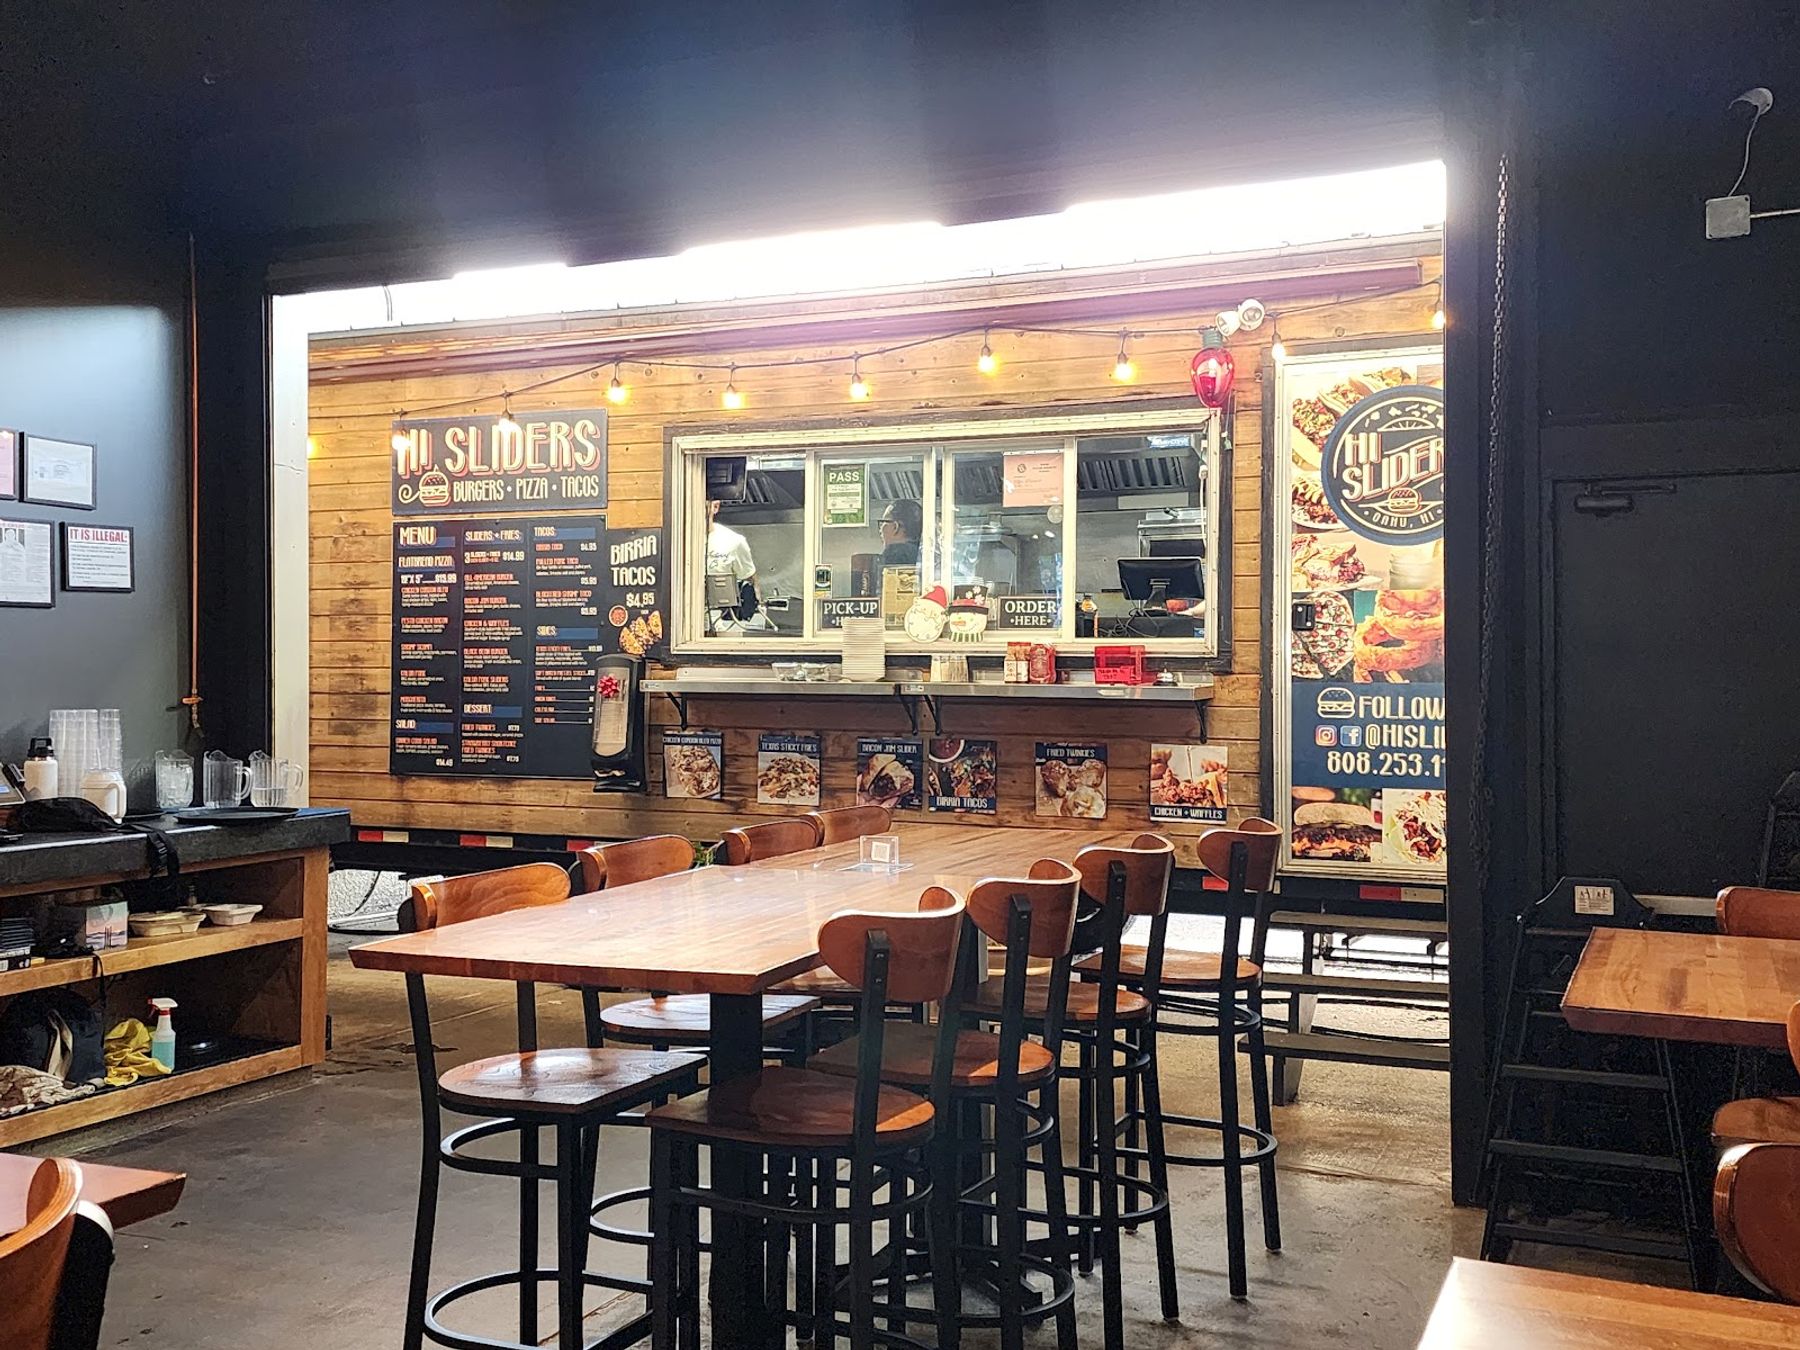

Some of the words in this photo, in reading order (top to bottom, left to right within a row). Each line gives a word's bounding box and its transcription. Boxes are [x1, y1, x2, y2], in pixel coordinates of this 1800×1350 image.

[394, 427, 431, 478] HI
[445, 419, 601, 477] SLIDERS
[1345, 432, 1382, 467] HI
[1341, 437, 1444, 502] SLIDER
[829, 471, 860, 483] PASS
[453, 479, 505, 503] BURGERS
[515, 477, 549, 500] PIZZA
[560, 475, 600, 498] TACOS
[70, 529, 80, 539] IT
[81, 530, 91, 540] IS
[399, 526, 437, 546] MENU
[464, 530, 494, 543] SLIDERS
[500, 529, 522, 542] FRIES
[534, 526, 557, 538] TACOS
[464, 551, 471, 564] 3
[610, 535, 657, 566] BIRRIA
[610, 566, 656, 587] TACOS
[823, 602, 878, 616] PICK-UP
[1004, 600, 1058, 614] ORDER
[536, 625, 558, 637] SIDES
[463, 703, 493, 714] DESSERT
[1358, 695, 1445, 720] FOLLOW
[395, 719, 417, 730] SALAD
[1046, 748, 1065, 758] FRIED
[963, 797, 988, 809] TACOS
[1154, 806, 1183, 817] CHICKEN
[1190, 808, 1224, 820] WAFFLES
